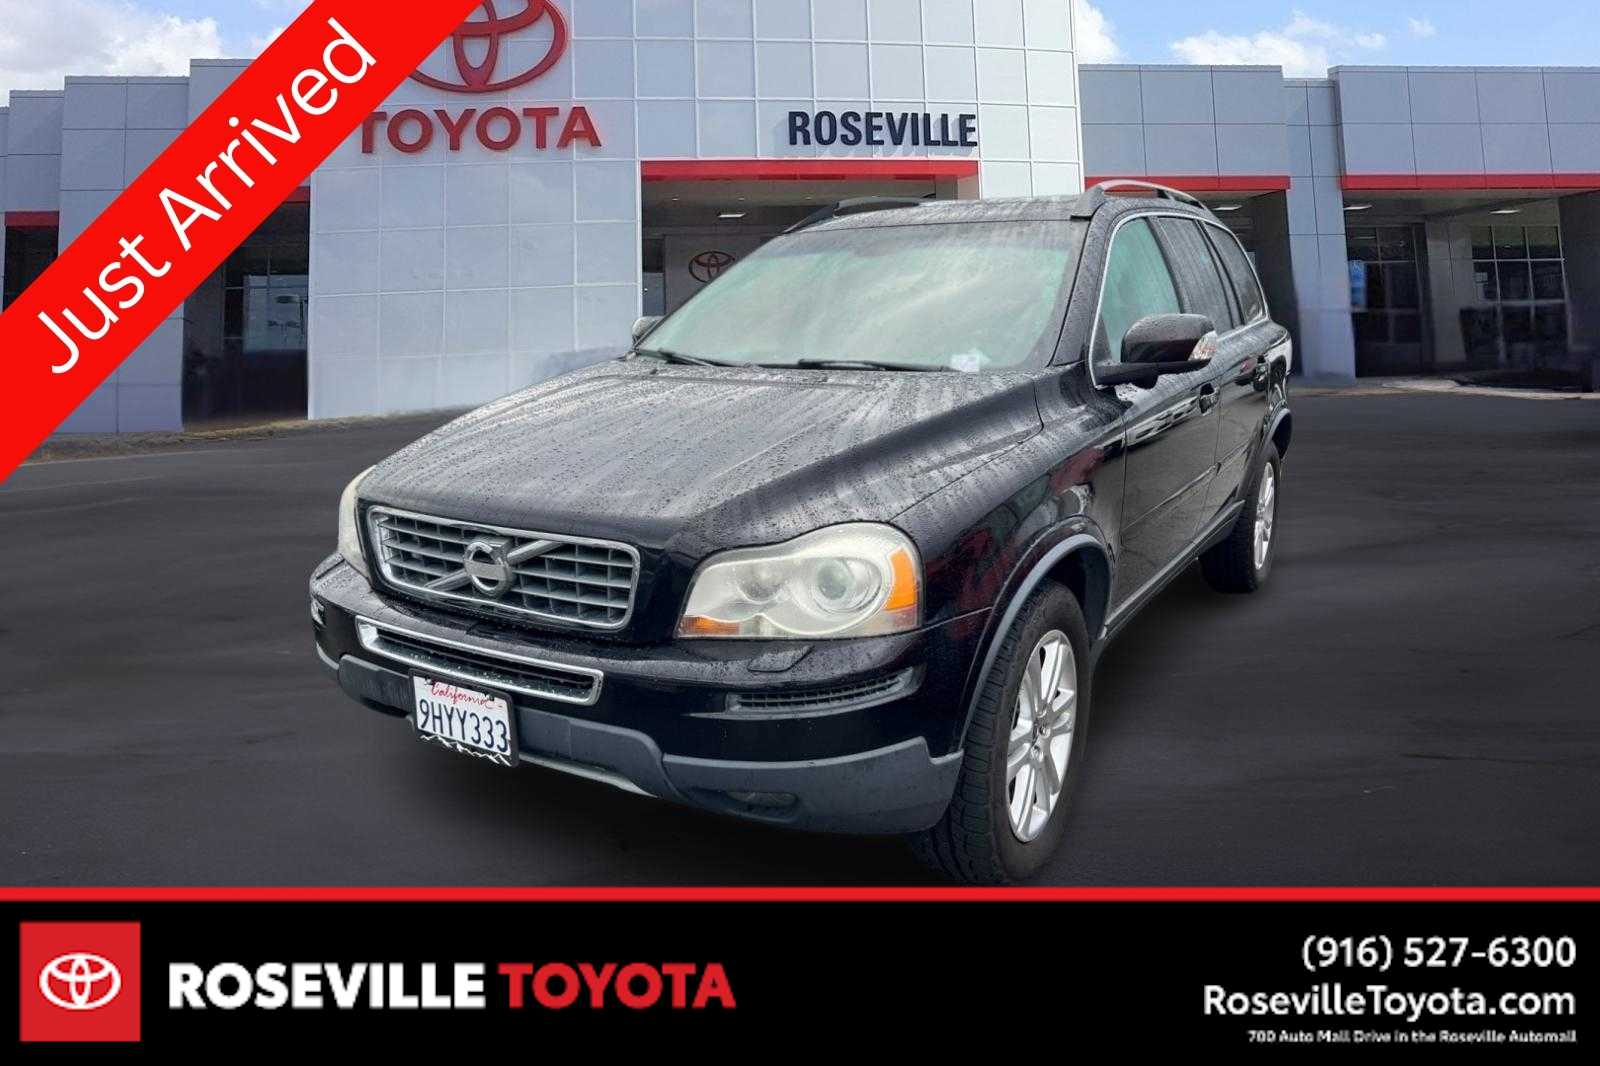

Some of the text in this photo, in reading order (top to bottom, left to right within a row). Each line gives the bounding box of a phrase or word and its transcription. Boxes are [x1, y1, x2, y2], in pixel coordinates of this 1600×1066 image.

[361, 106, 601, 153] TOYOTA
[788, 111, 978, 147] ROSEVILLE
[431, 681, 495, 709] California
[419, 698, 509, 753] 9HYY333
